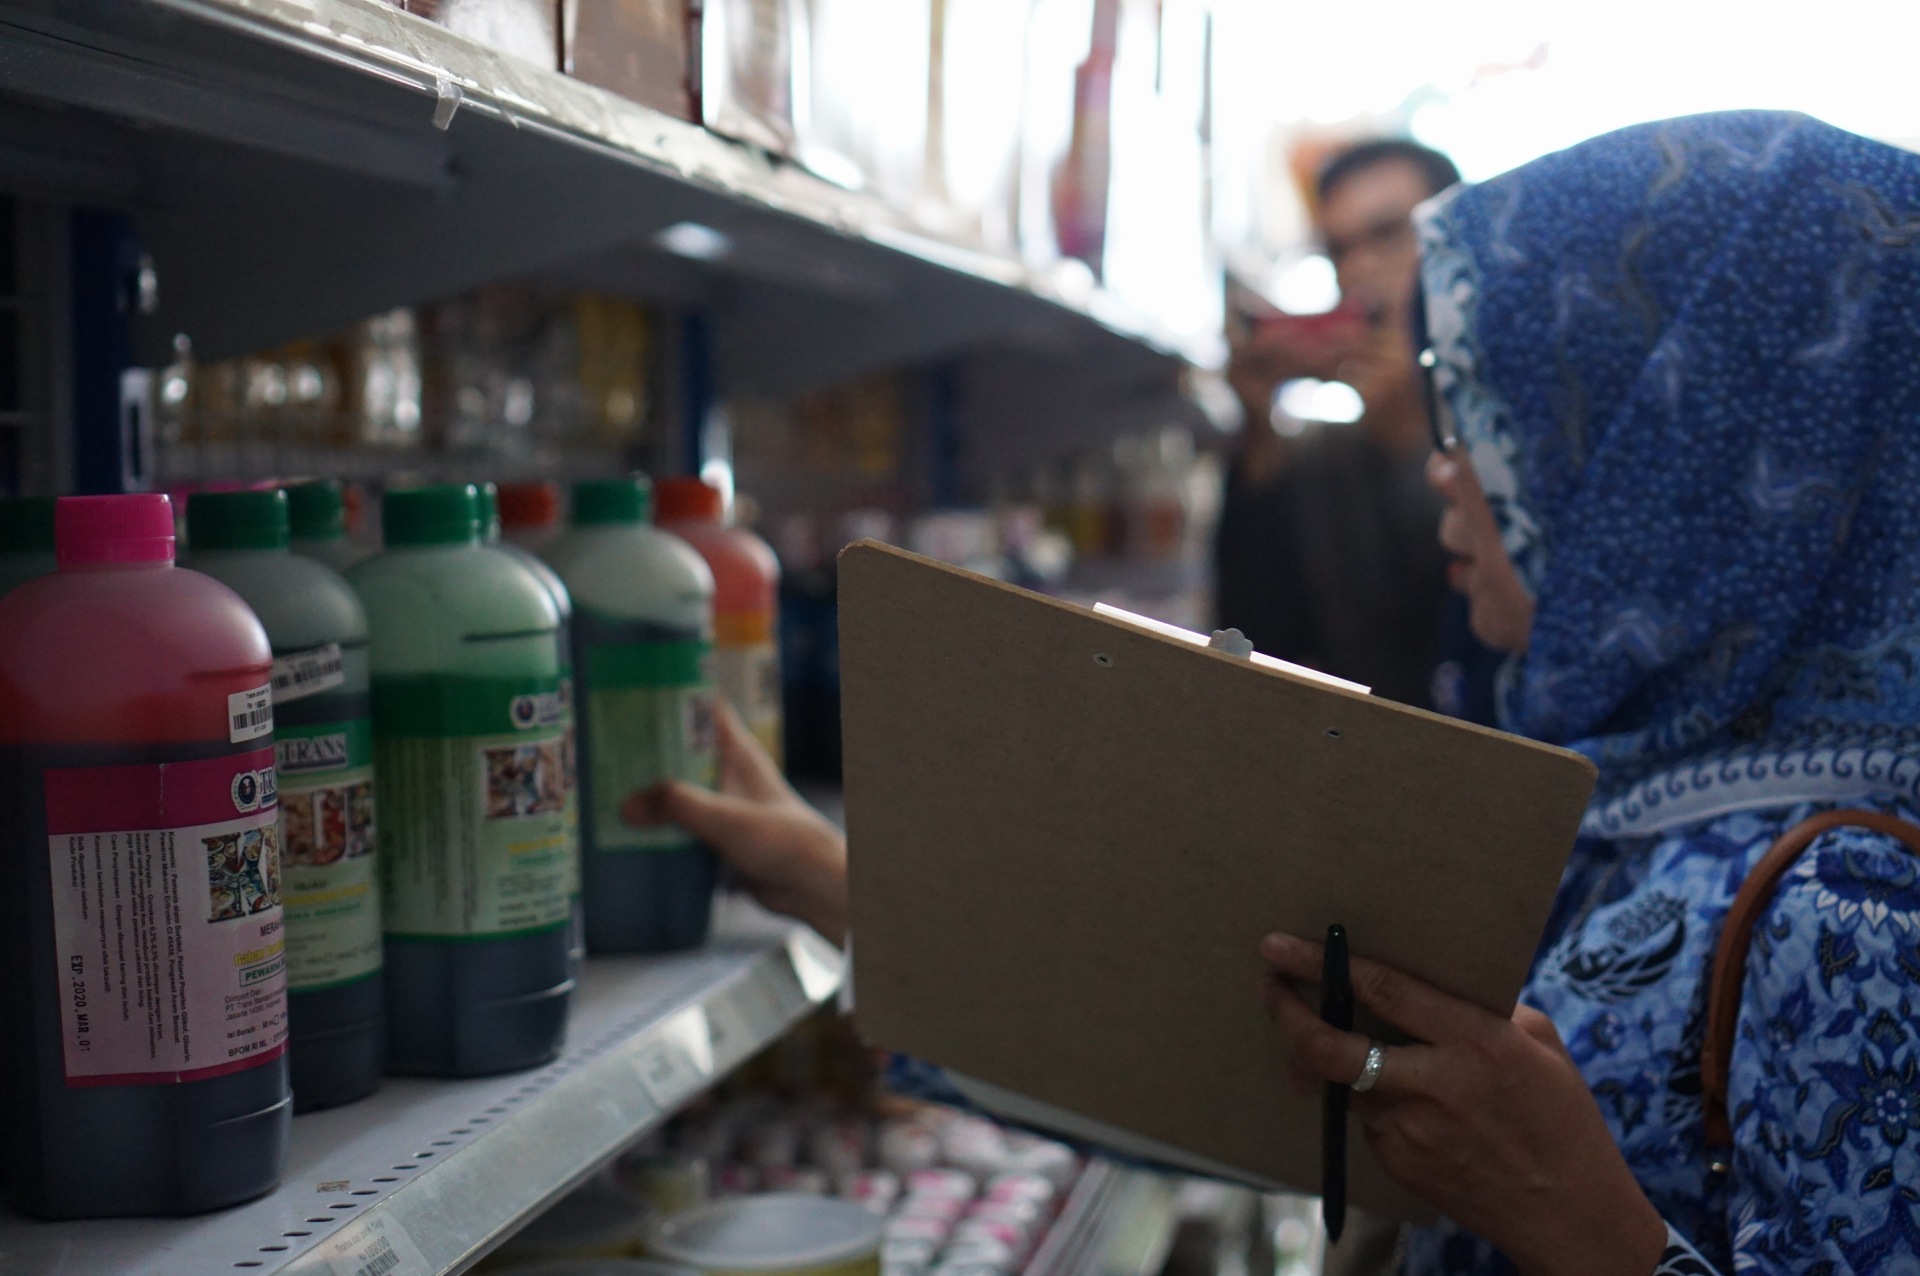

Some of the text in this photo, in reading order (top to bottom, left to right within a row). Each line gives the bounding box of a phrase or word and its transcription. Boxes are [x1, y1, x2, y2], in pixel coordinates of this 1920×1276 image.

[168, 832, 177, 869] Komposisi
[78, 853, 86, 889] digunakan
[162, 863, 170, 894] Makanan
[132, 919, 140, 948] pewarna
[143, 963, 152, 987] produk
[228, 1044, 250, 1057] BPOM
